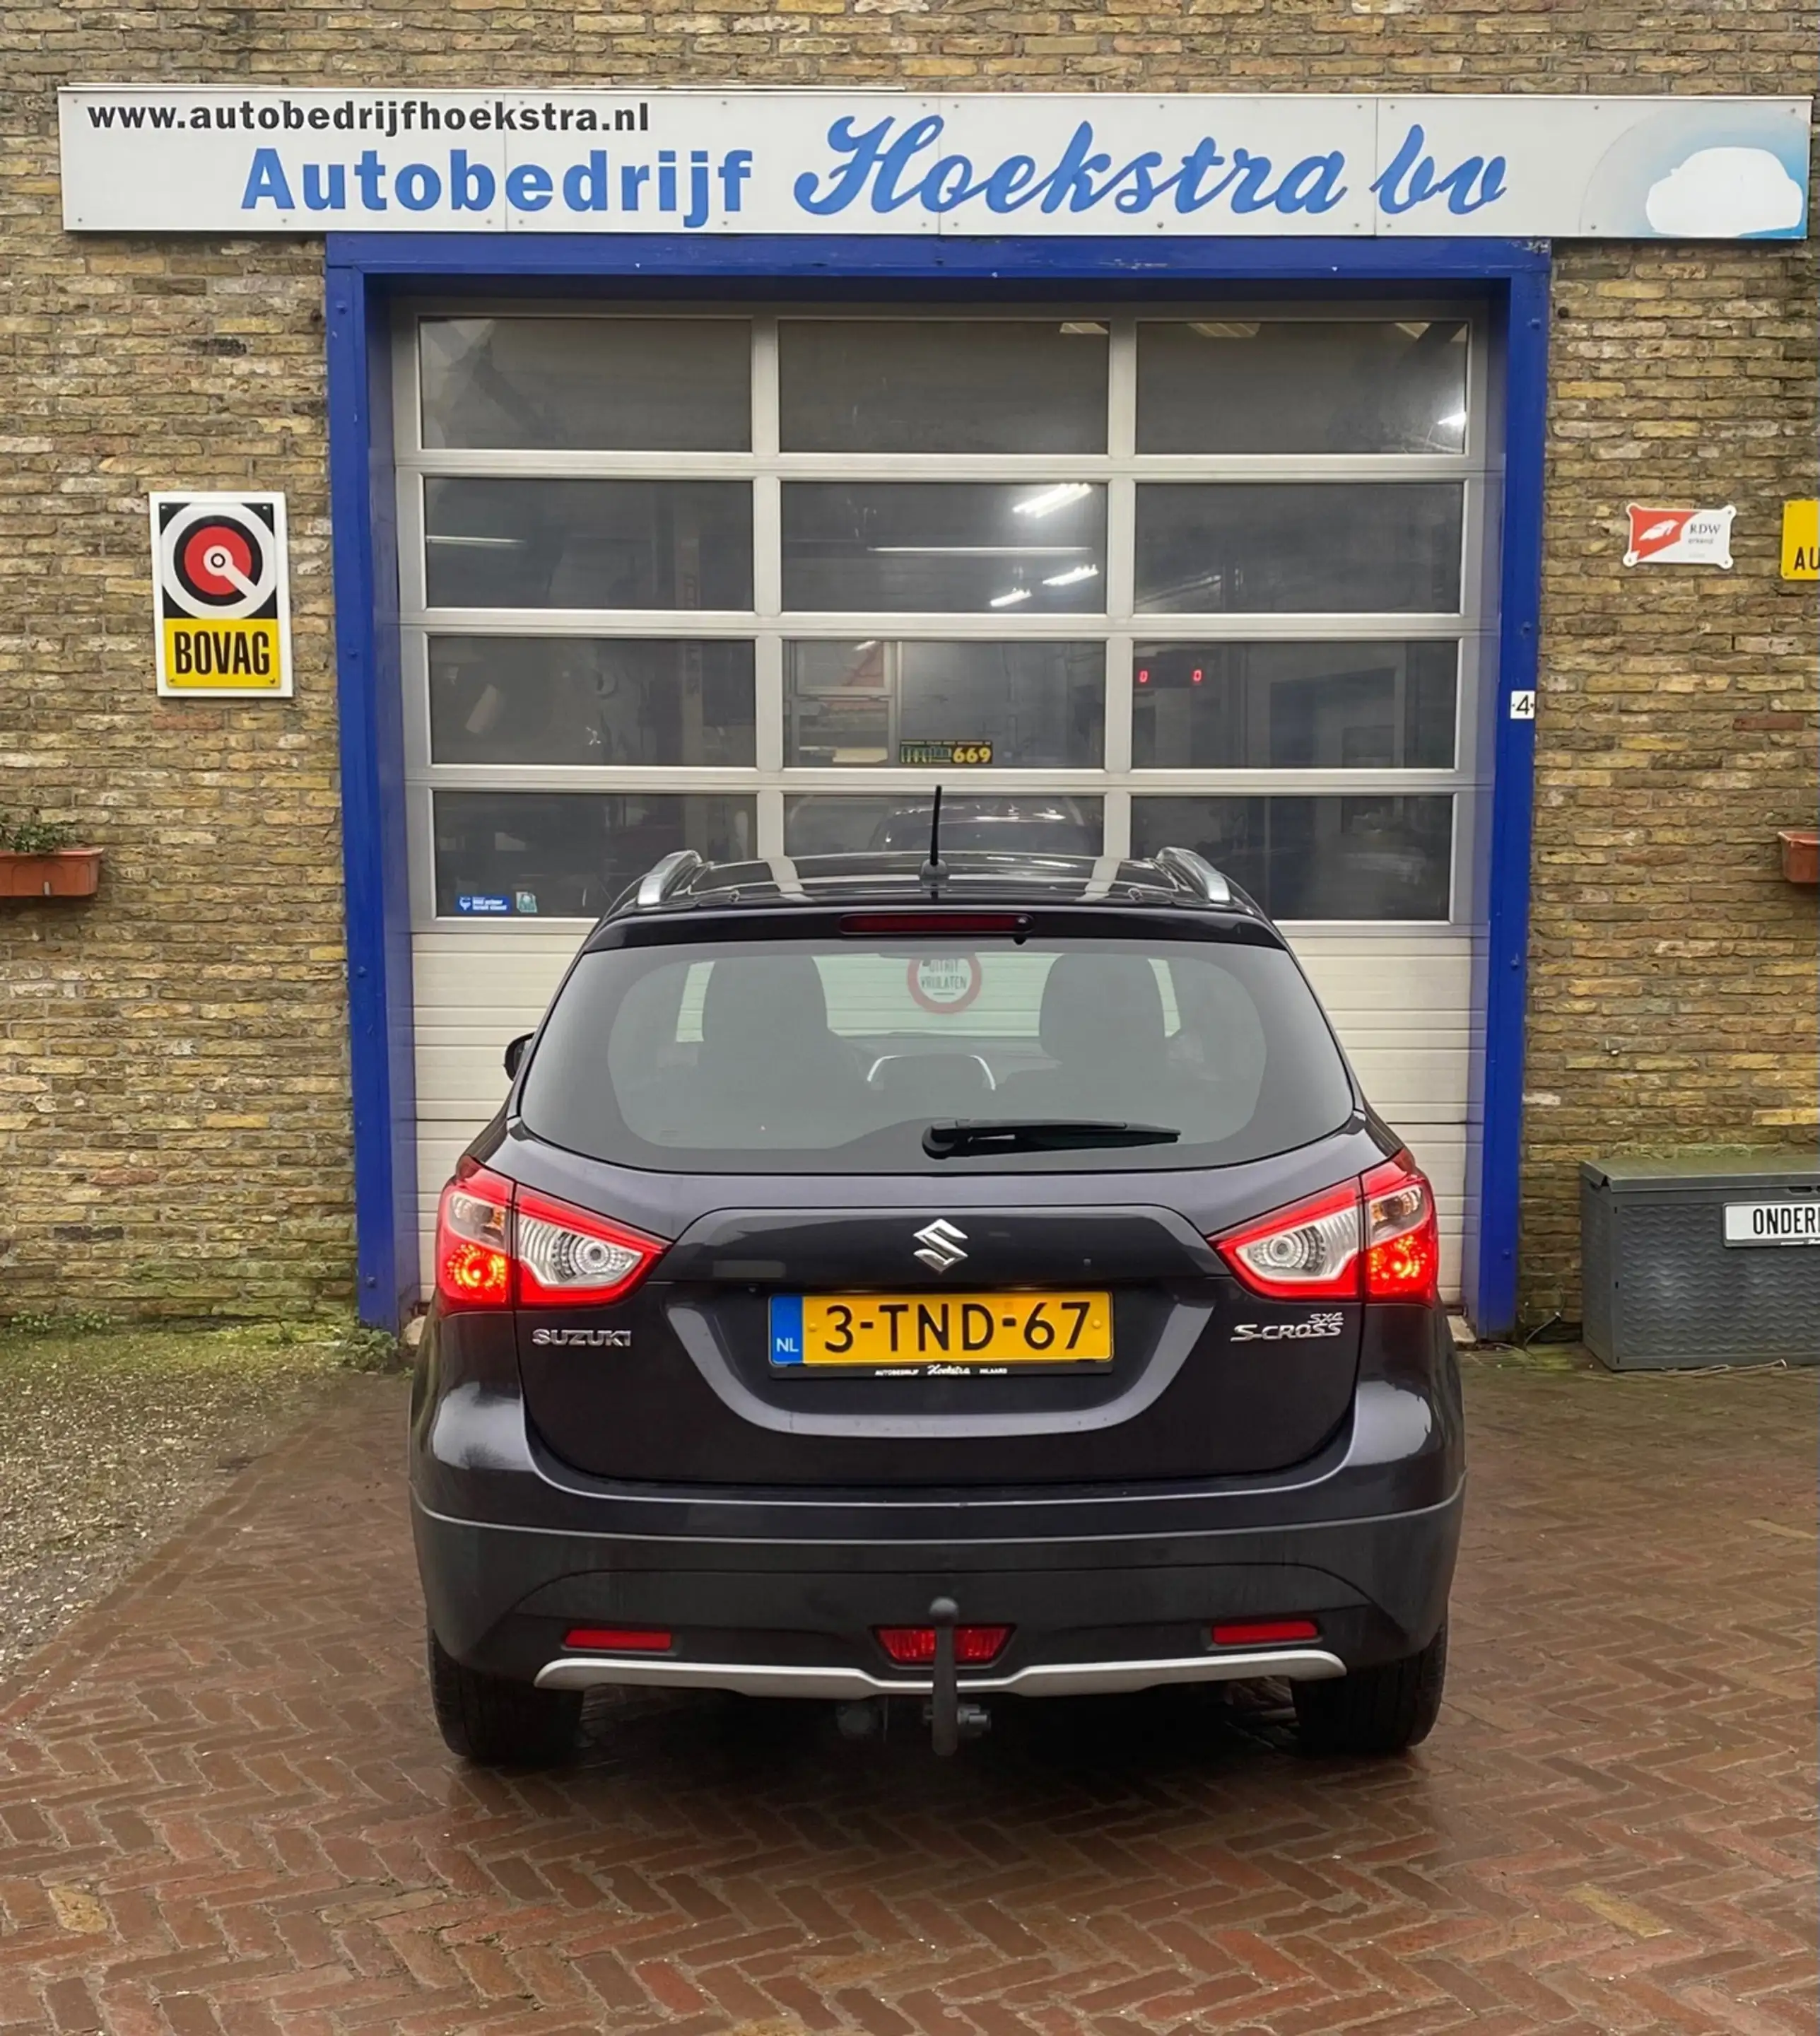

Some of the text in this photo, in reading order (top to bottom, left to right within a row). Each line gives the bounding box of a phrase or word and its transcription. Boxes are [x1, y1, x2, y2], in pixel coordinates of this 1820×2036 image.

[87, 100, 650, 138] www.autobedrijfhoekstra.nl
[241, 115, 1507, 229] Autobedrijf Hoekstra bv
[1689, 523, 1721, 535] RDW
[174, 630, 270, 675] BOVAG
[1515, 694, 1530, 715] 4
[953, 747, 991, 764] 669
[1753, 1207, 1820, 1235] ONDER
[532, 1328, 631, 1347] SUZUKI
[824, 1301, 1091, 1353] 3-TND-67
[1230, 1322, 1344, 1342] S-CROSS
[776, 1338, 799, 1352] NL
